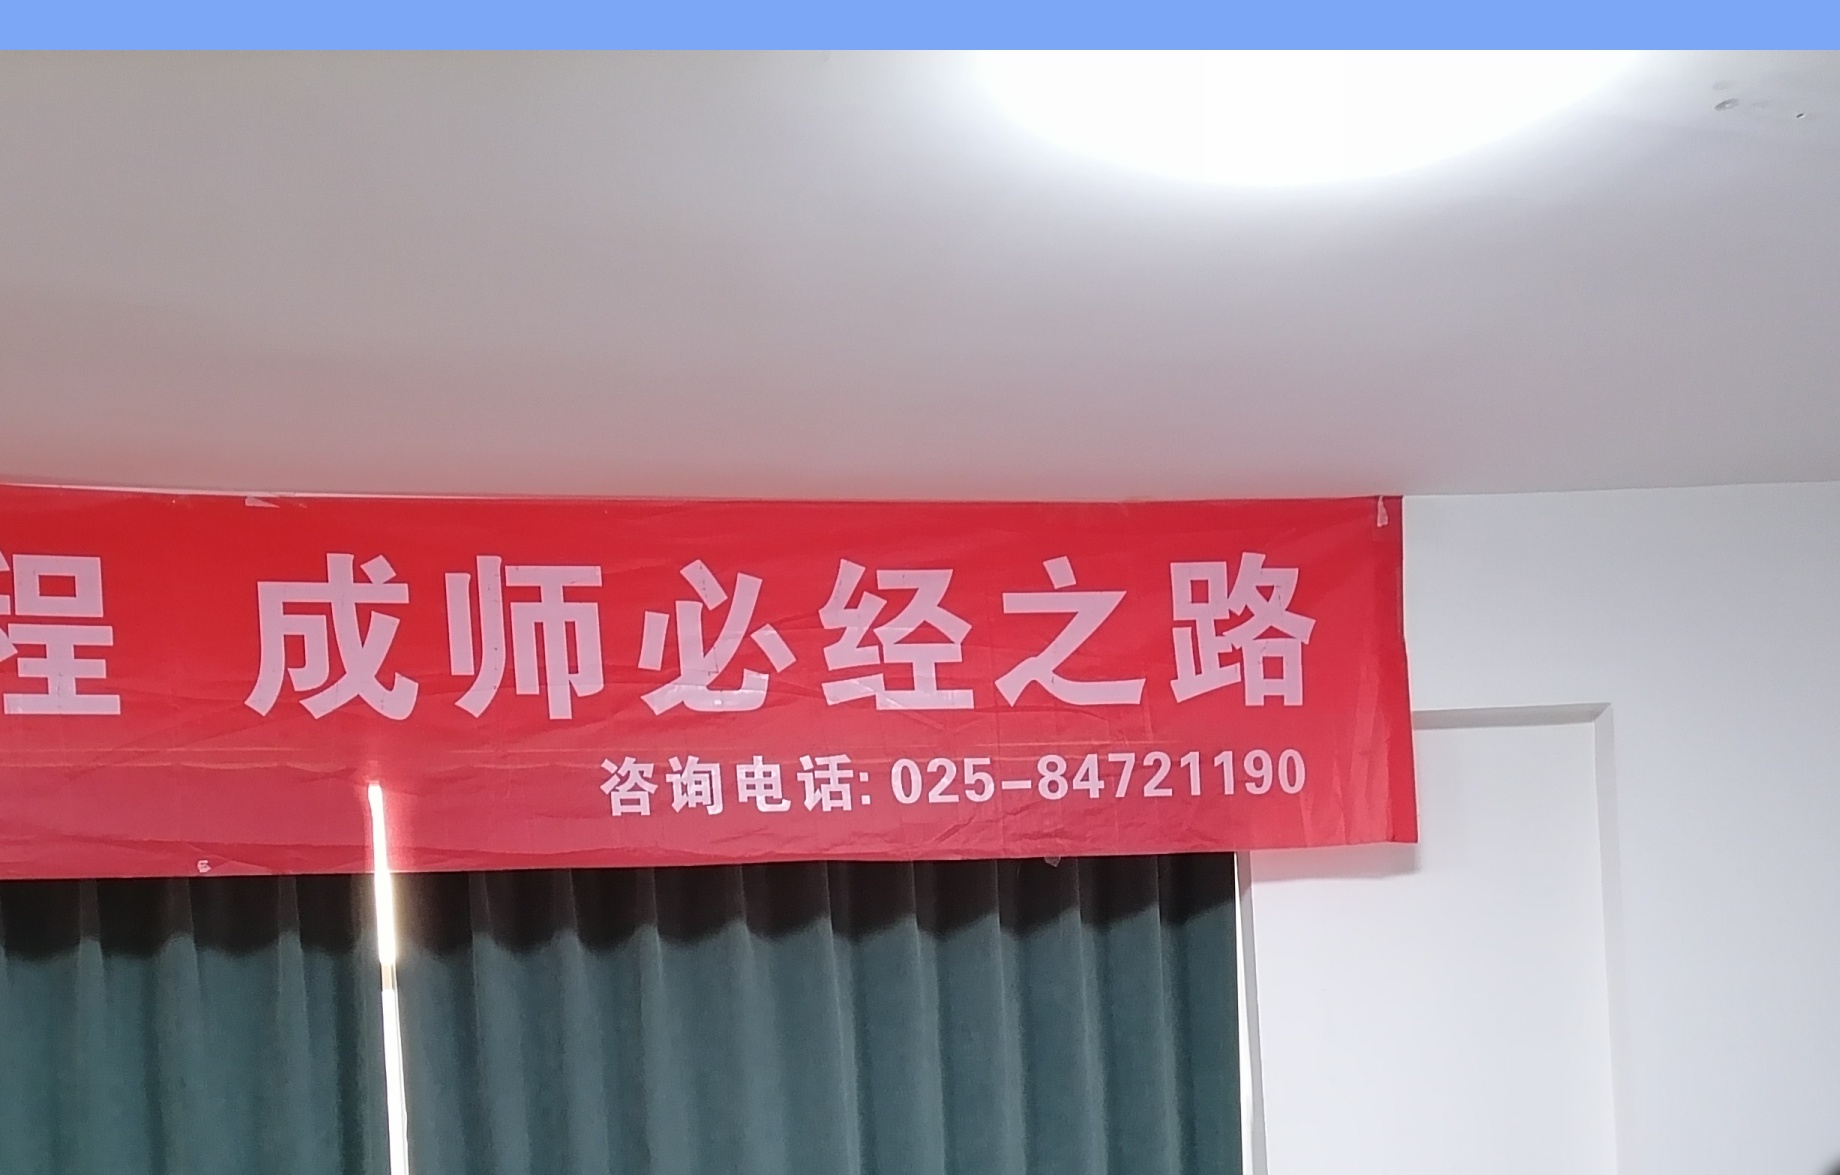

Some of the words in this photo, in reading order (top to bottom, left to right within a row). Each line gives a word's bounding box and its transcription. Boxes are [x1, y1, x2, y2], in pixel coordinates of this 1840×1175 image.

[244, 552, 1317, 720] 成师必经之路
[890, 748, 1306, 804] 025-84721190
